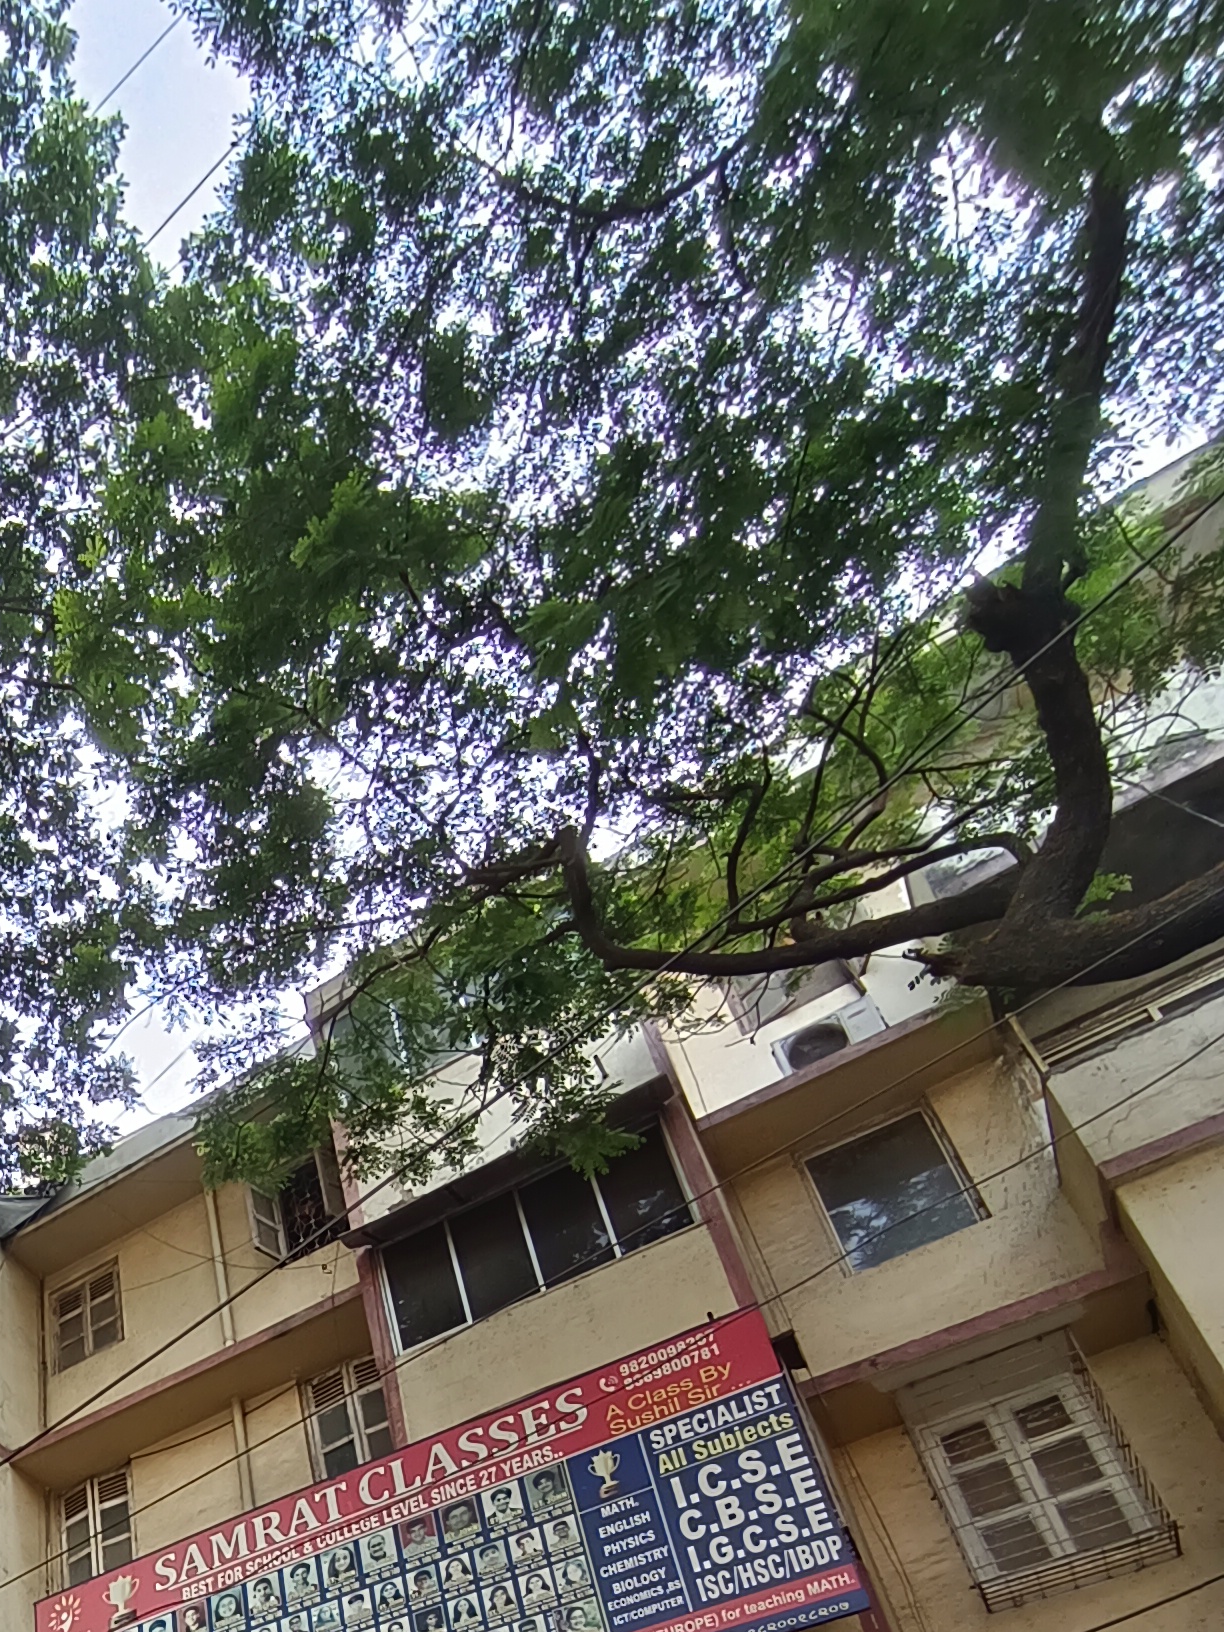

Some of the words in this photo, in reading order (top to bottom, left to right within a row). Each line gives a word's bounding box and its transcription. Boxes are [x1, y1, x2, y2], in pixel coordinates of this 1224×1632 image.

[606, 1404, 624, 1421] A
[628, 1377, 693, 1410] Class
[699, 1361, 732, 1383] By
[609, 1397, 681, 1435] Sushil
[687, 1383, 721, 1406] Sir
[650, 1384, 781, 1449] SPECIALIST
[659, 1447, 687, 1474] All
[692, 1411, 794, 1460] Subjects
[670, 1433, 810, 1508] I.C.S.E
[154, 1482, 347, 1592] SAMRAT
[358, 1386, 589, 1506] CLASSES
[678, 1468, 823, 1542] C.B.S.E
[182, 1576, 214, 1601] BEST
[217, 1564, 243, 1589] FOR
[245, 1546, 300, 1576] SCHOOL
[302, 1541, 314, 1554] &
[316, 1515, 381, 1546] COLLEGE
[382, 1495, 428, 1524] LEVEL
[431, 1474, 477, 1502] SINCE
[479, 1467, 497, 1487] 27
[598, 1511, 651, 1538] ENGLISH
[603, 1529, 656, 1557] PHYSICS
[686, 1503, 834, 1573] I.G.C.S.E
[599, 1545, 669, 1578] CHEMISTRY
[612, 1566, 667, 1595] BIOLOGY
[696, 1535, 843, 1603] ISC/HSC/IBDP
[607, 1585, 664, 1611] ECONOMICS
[613, 1596, 684, 1626] ICT/COMPUTER
[721, 1604, 741, 1622] for
[743, 1589, 805, 1615] teaching
